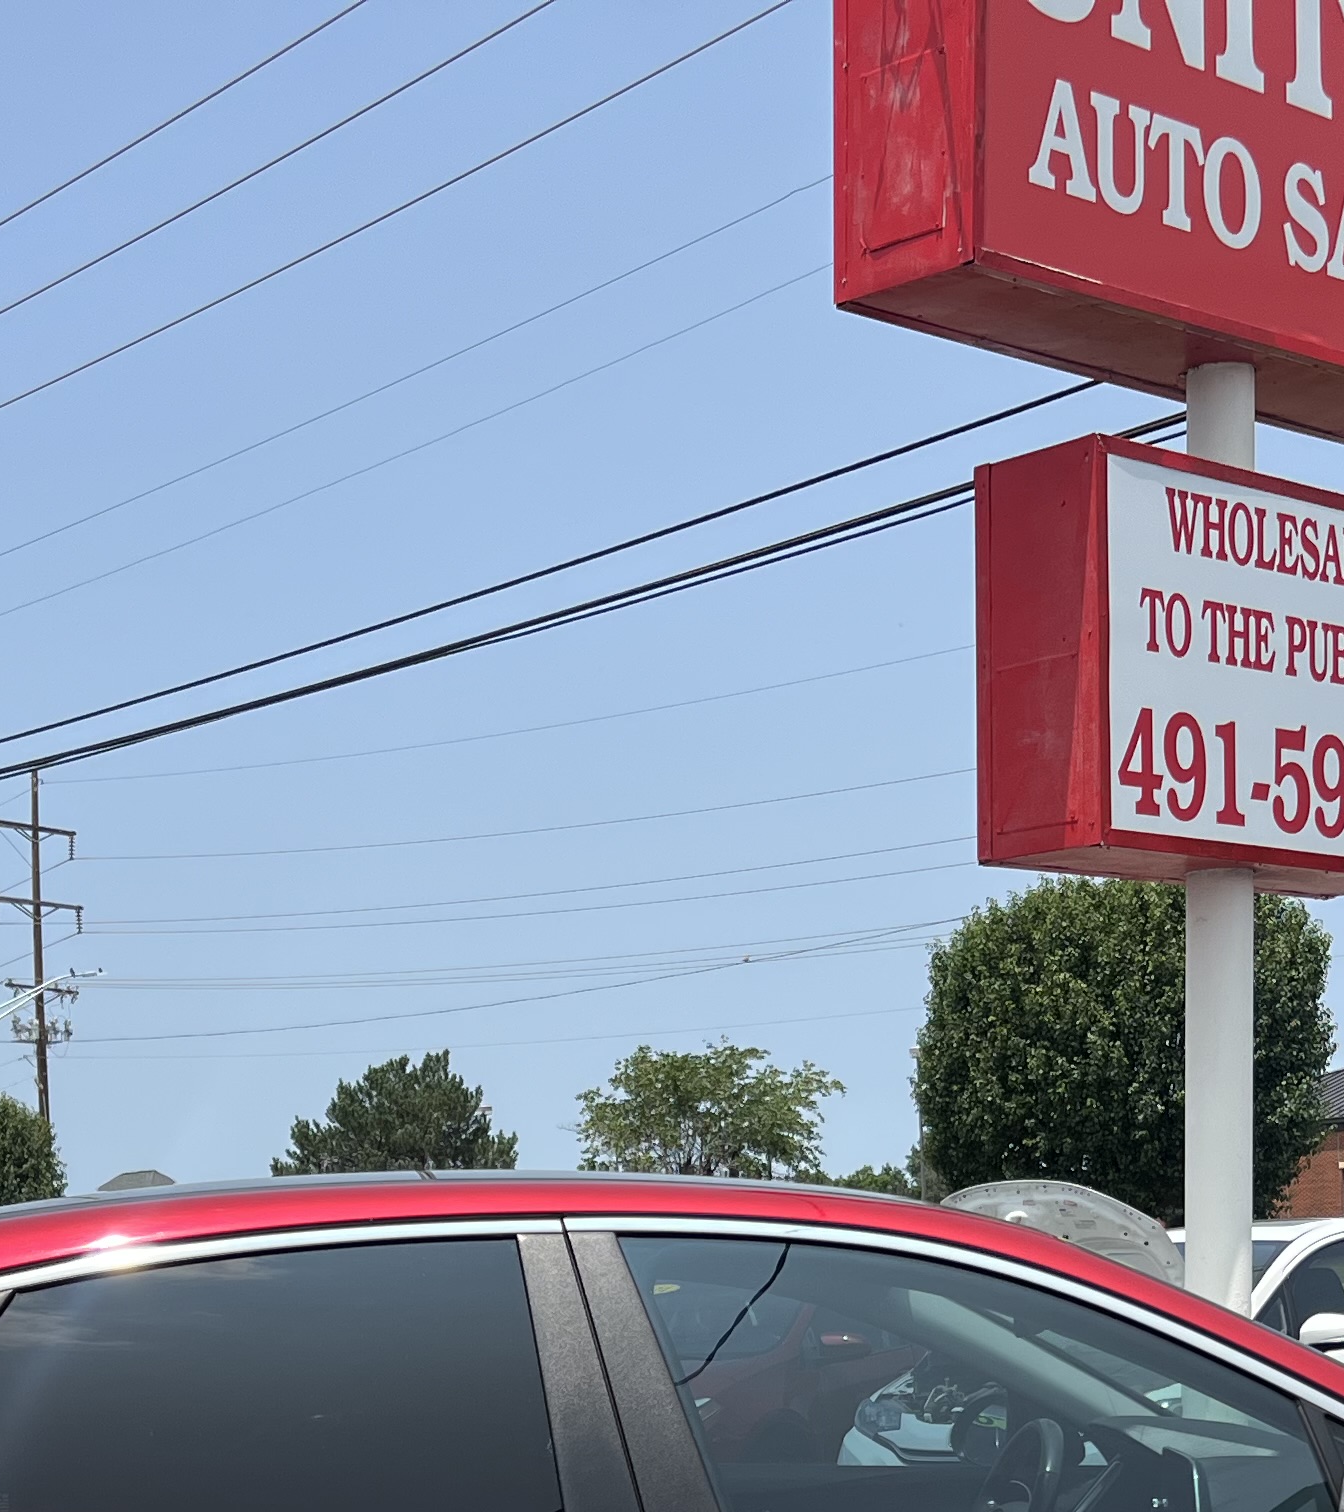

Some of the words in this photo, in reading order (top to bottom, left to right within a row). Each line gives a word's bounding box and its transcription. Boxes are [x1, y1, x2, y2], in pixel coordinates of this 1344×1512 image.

[1028, 79, 1261, 249] AUTO
[1140, 587, 1192, 658] TO
[1201, 600, 1276, 673] THE
